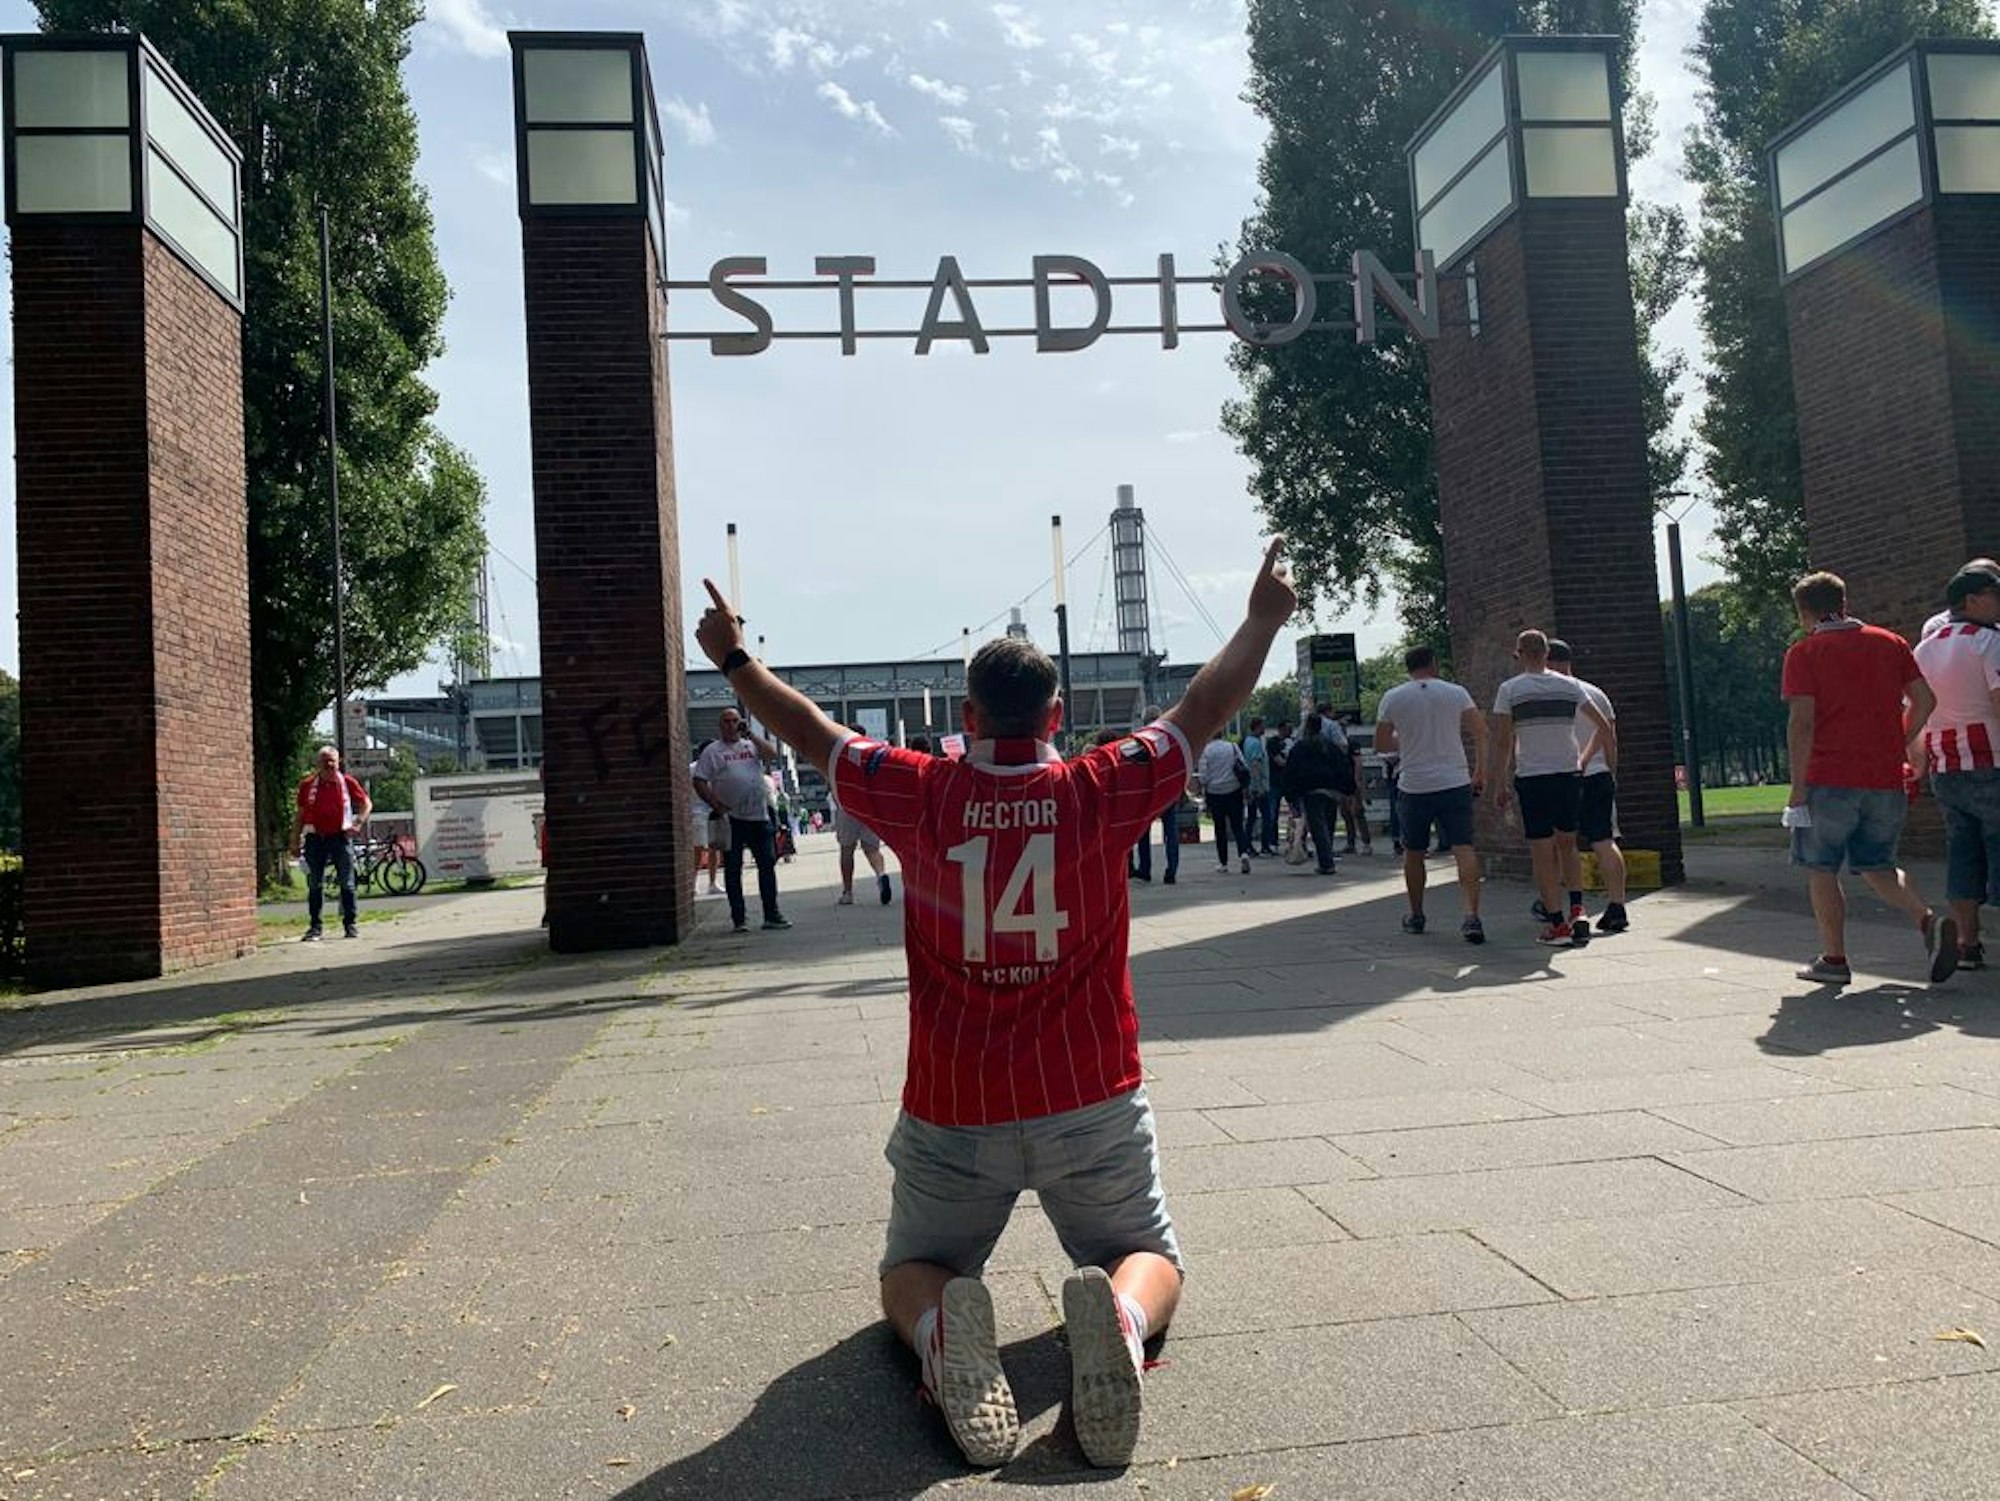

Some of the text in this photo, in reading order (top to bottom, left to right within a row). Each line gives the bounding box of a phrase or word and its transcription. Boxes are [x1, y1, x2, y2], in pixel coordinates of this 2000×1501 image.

[709, 249, 1440, 356] STADION
[963, 799, 1058, 829] HECTOR
[945, 833, 1069, 962] 14
